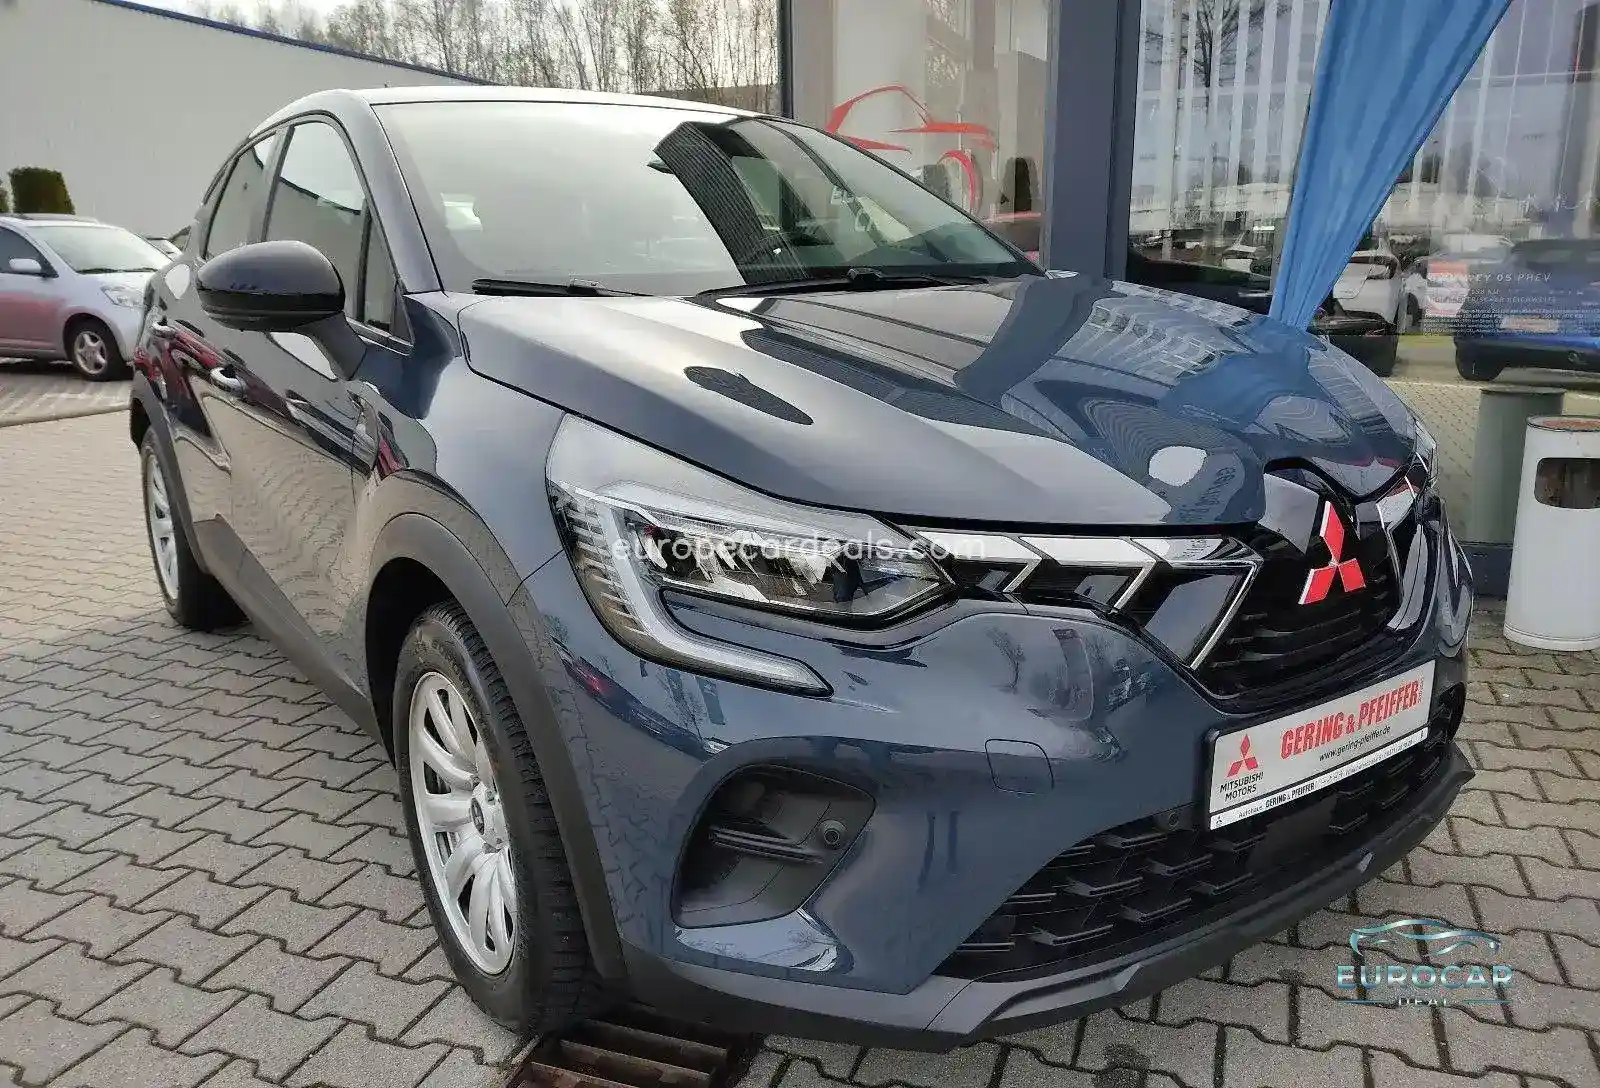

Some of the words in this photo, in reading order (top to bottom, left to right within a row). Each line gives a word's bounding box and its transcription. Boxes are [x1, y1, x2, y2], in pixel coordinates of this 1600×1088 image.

[1517, 273, 1552, 283] PHEV
[1281, 711, 1344, 760] GERING
[1346, 714, 1355, 734] &
[1358, 680, 1420, 728] PFEIFFER
[1319, 726, 1391, 762] www.gering-pfeiffer.de
[1220, 772, 1264, 793] MITSUBISHI
[1225, 784, 1257, 802] MOTORS
[1265, 793, 1287, 809] GERING
[1291, 782, 1315, 799] PFEIFFER
